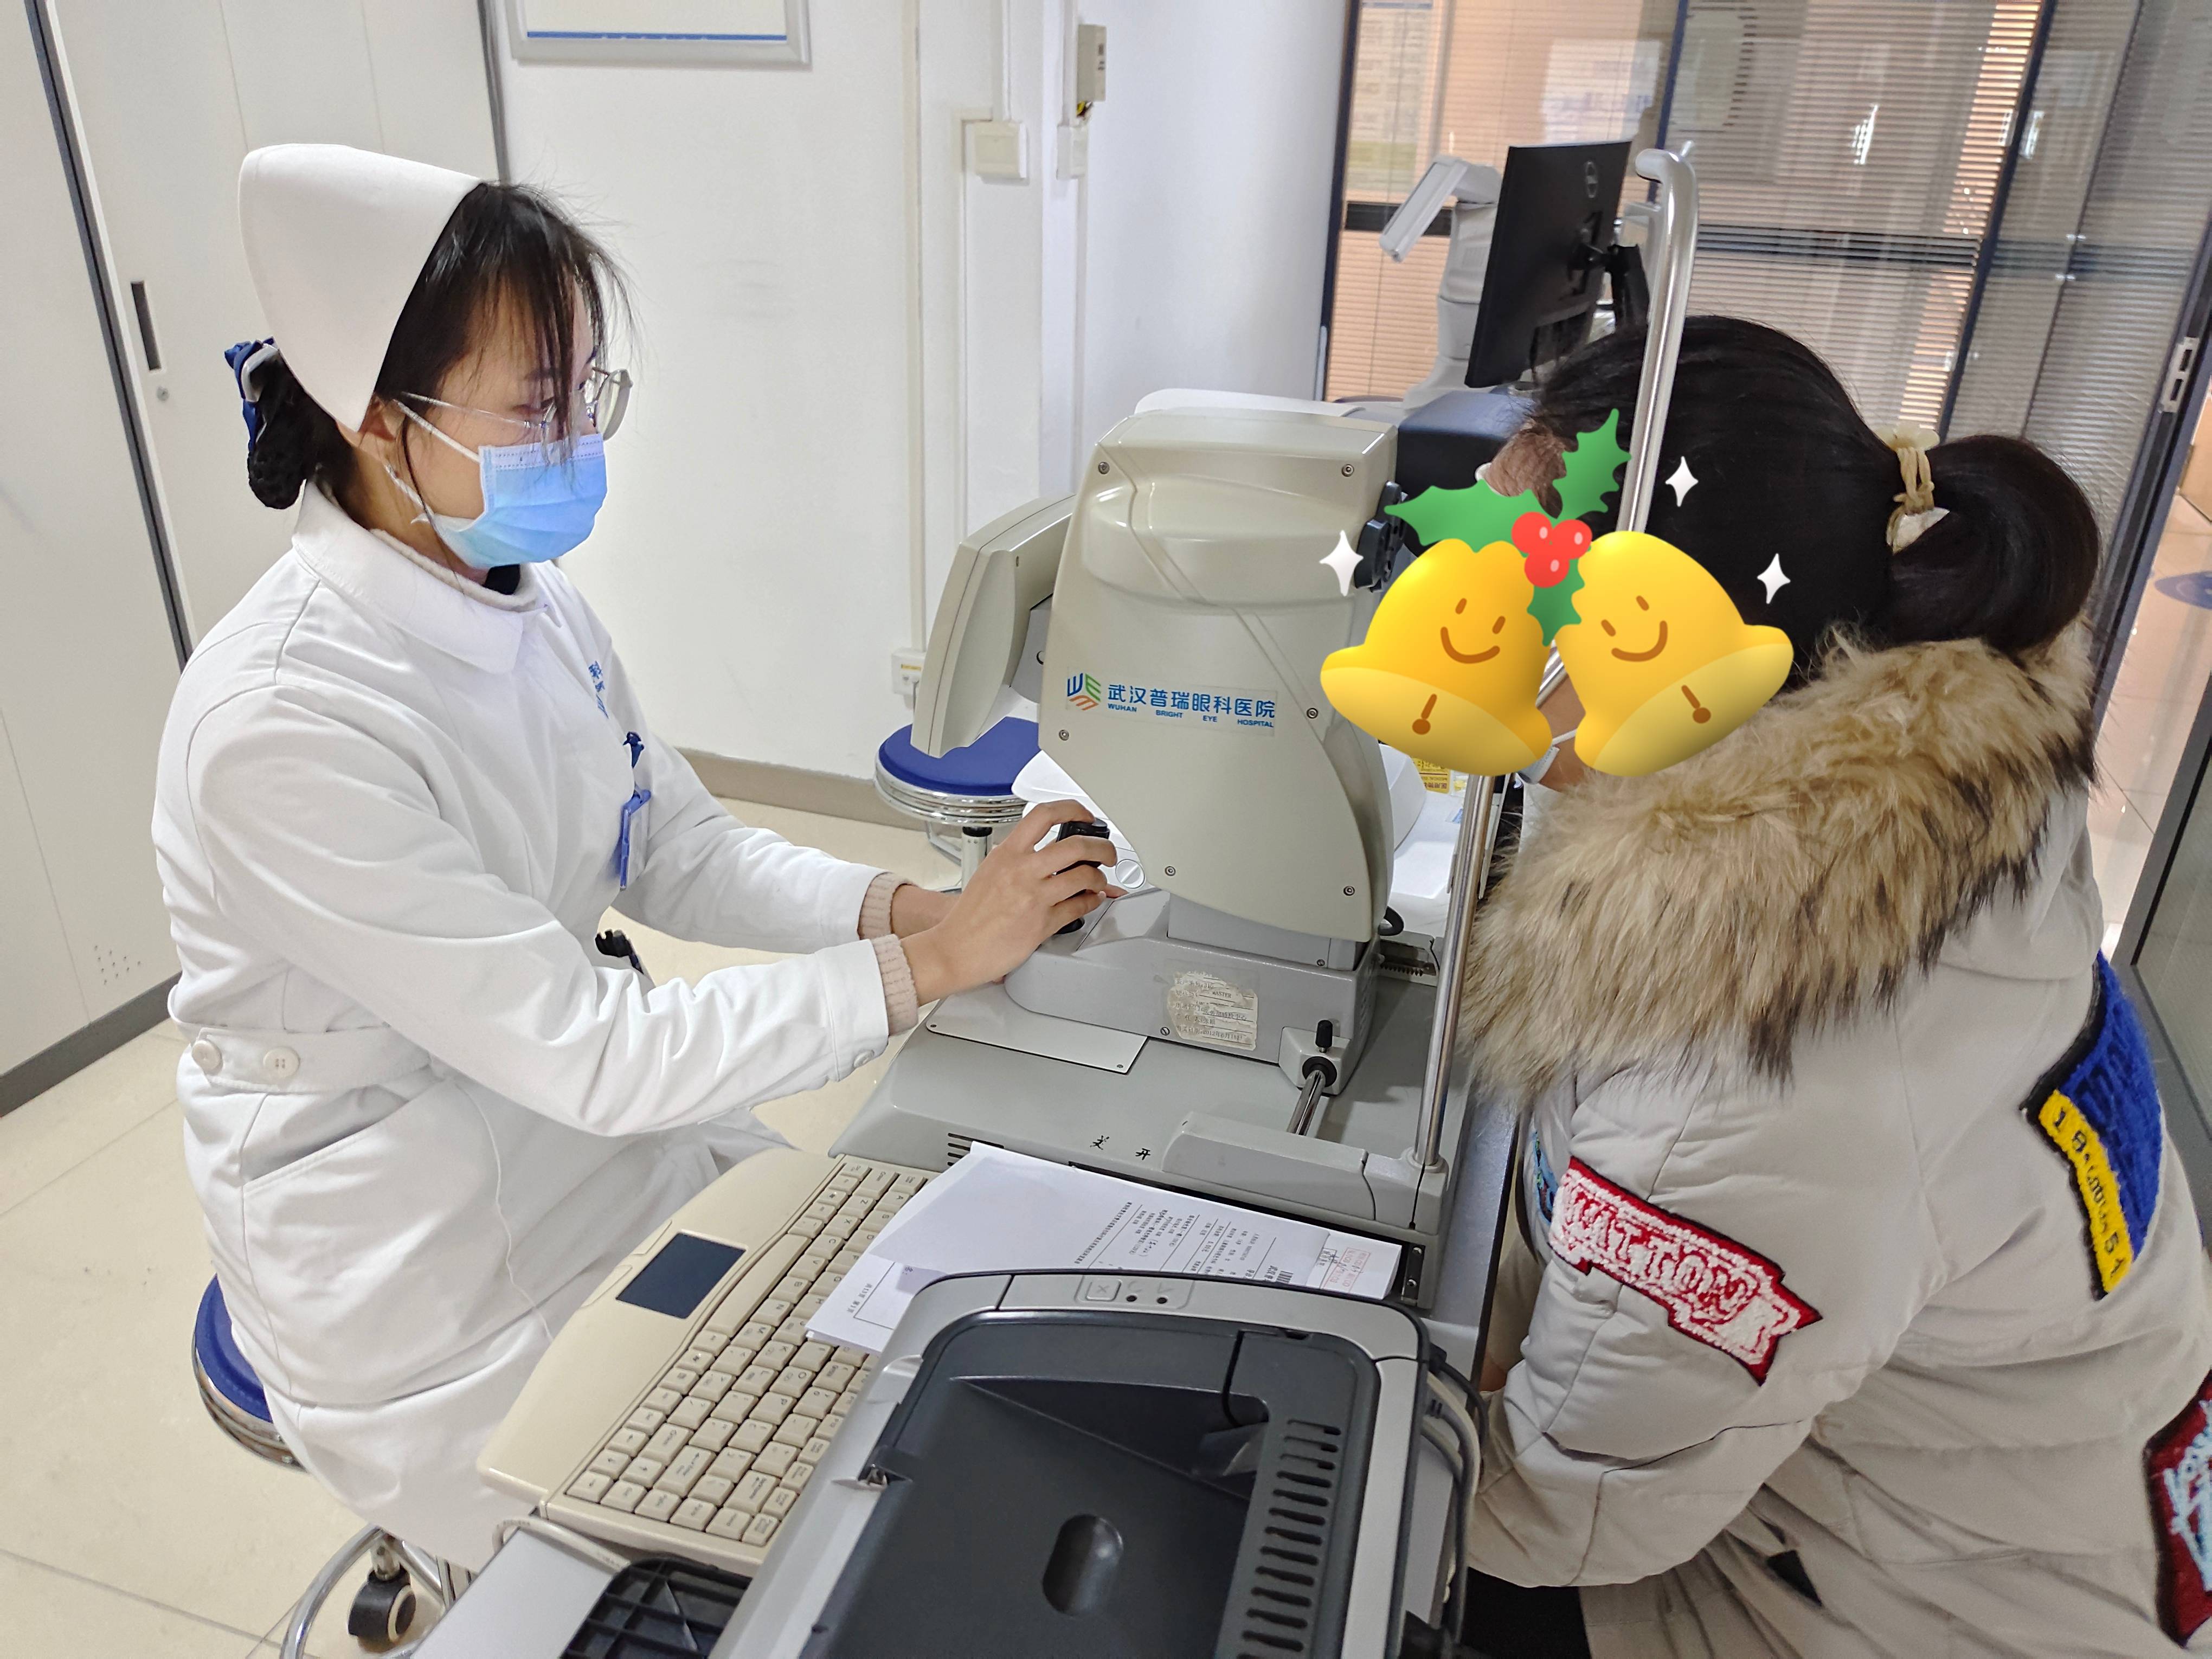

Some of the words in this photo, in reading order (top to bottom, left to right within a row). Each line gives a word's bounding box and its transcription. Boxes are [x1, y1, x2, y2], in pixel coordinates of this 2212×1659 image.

[1108, 684, 1275, 718] 武汉普瑞眼科医院
[1108, 703, 1137, 712] WUHAN
[1156, 710, 1184, 718] BRIGHT
[1237, 719, 1274, 728] HOSPITAL
[1135, 1148, 1151, 1161] 开
[1264, 1265, 1278, 1282] 武汉普
